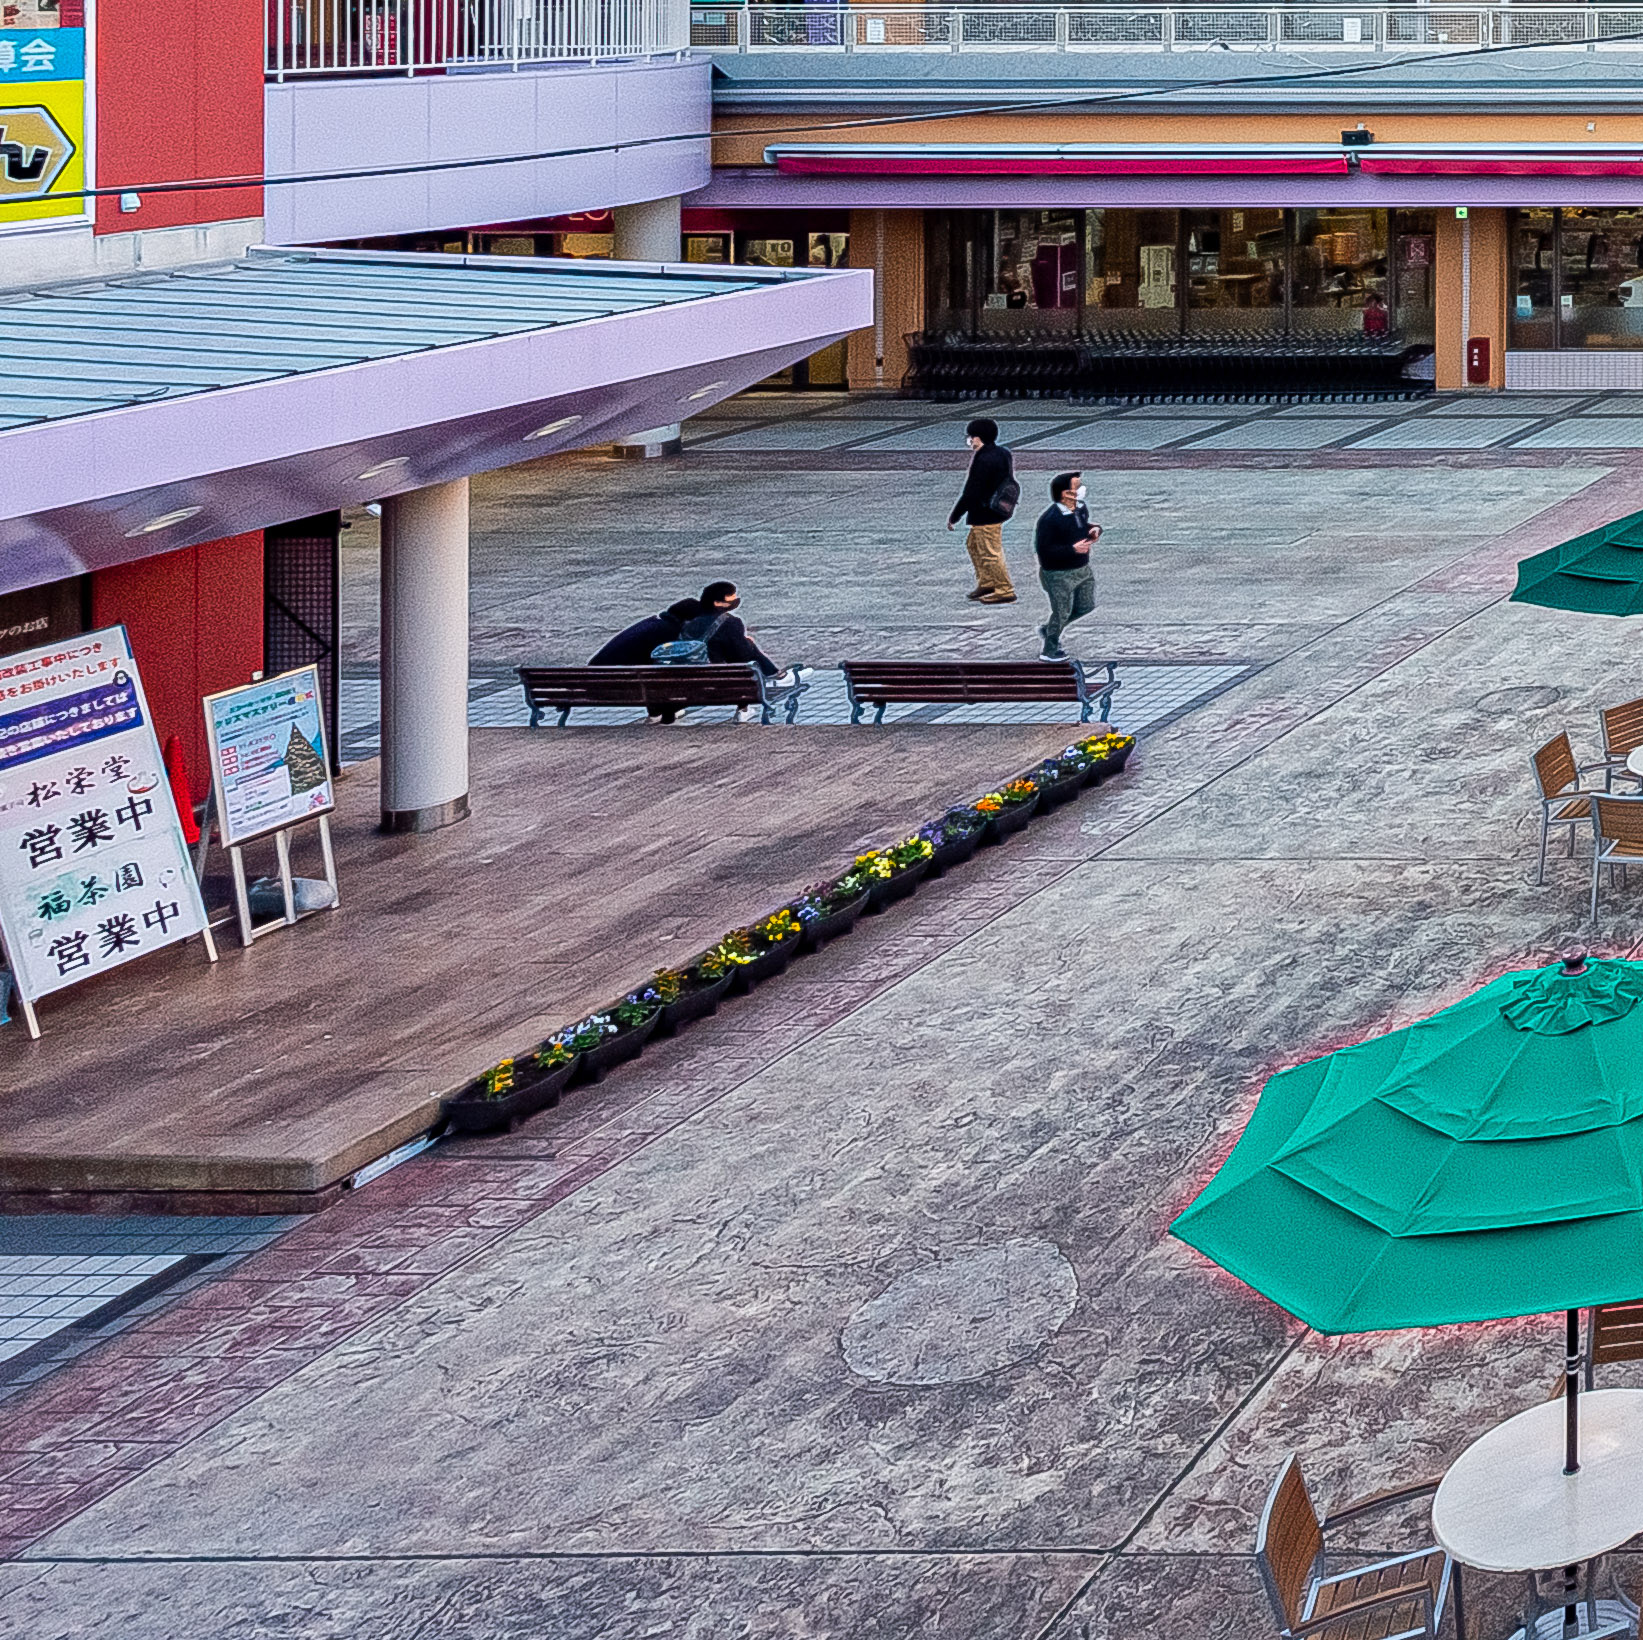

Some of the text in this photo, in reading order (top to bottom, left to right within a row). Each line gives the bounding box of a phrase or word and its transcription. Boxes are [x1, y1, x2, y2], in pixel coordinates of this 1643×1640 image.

[19, 796, 154, 869] 営業中
[37, 862, 144, 921] 福茶園
[47, 900, 180, 976] 営業中
